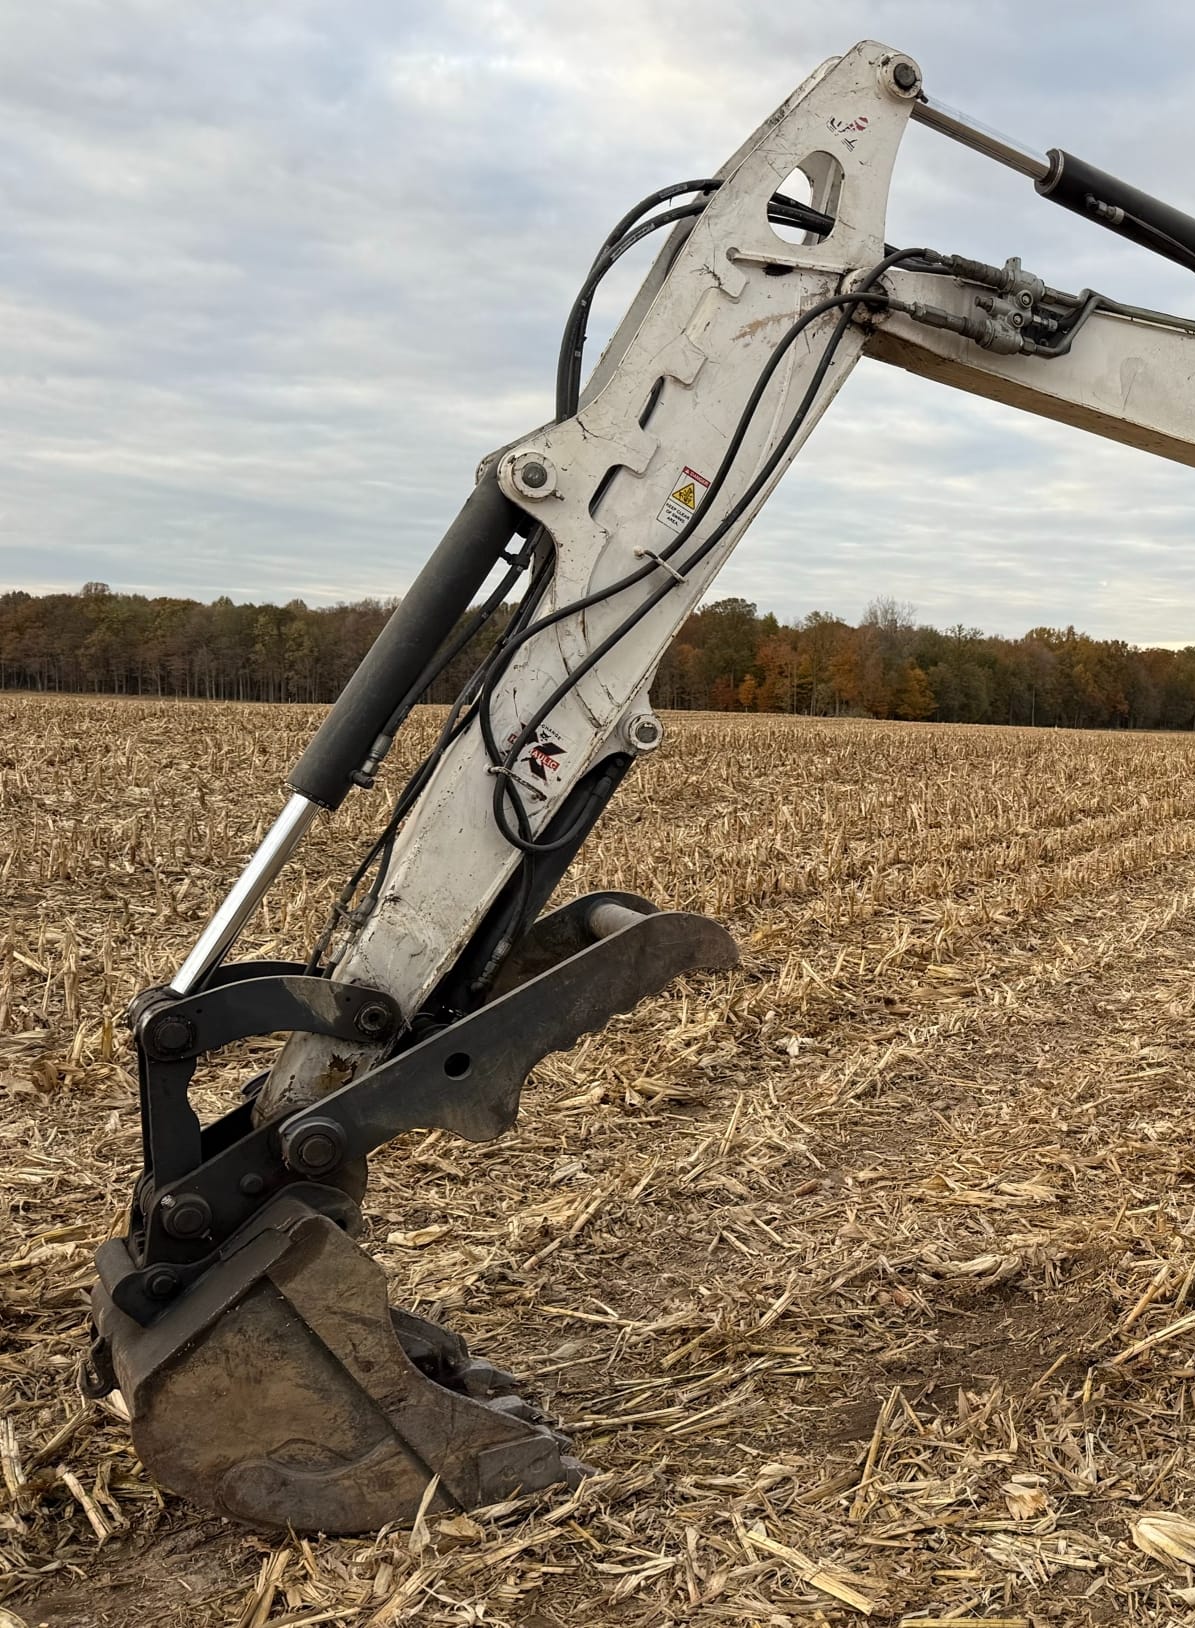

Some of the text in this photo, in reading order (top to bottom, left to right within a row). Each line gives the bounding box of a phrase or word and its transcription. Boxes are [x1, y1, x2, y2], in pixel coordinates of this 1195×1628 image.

[690, 470, 709, 487] DANGER
[666, 503, 690, 520] KEEP CLEAR
[509, 734, 559, 770] HAULIC
